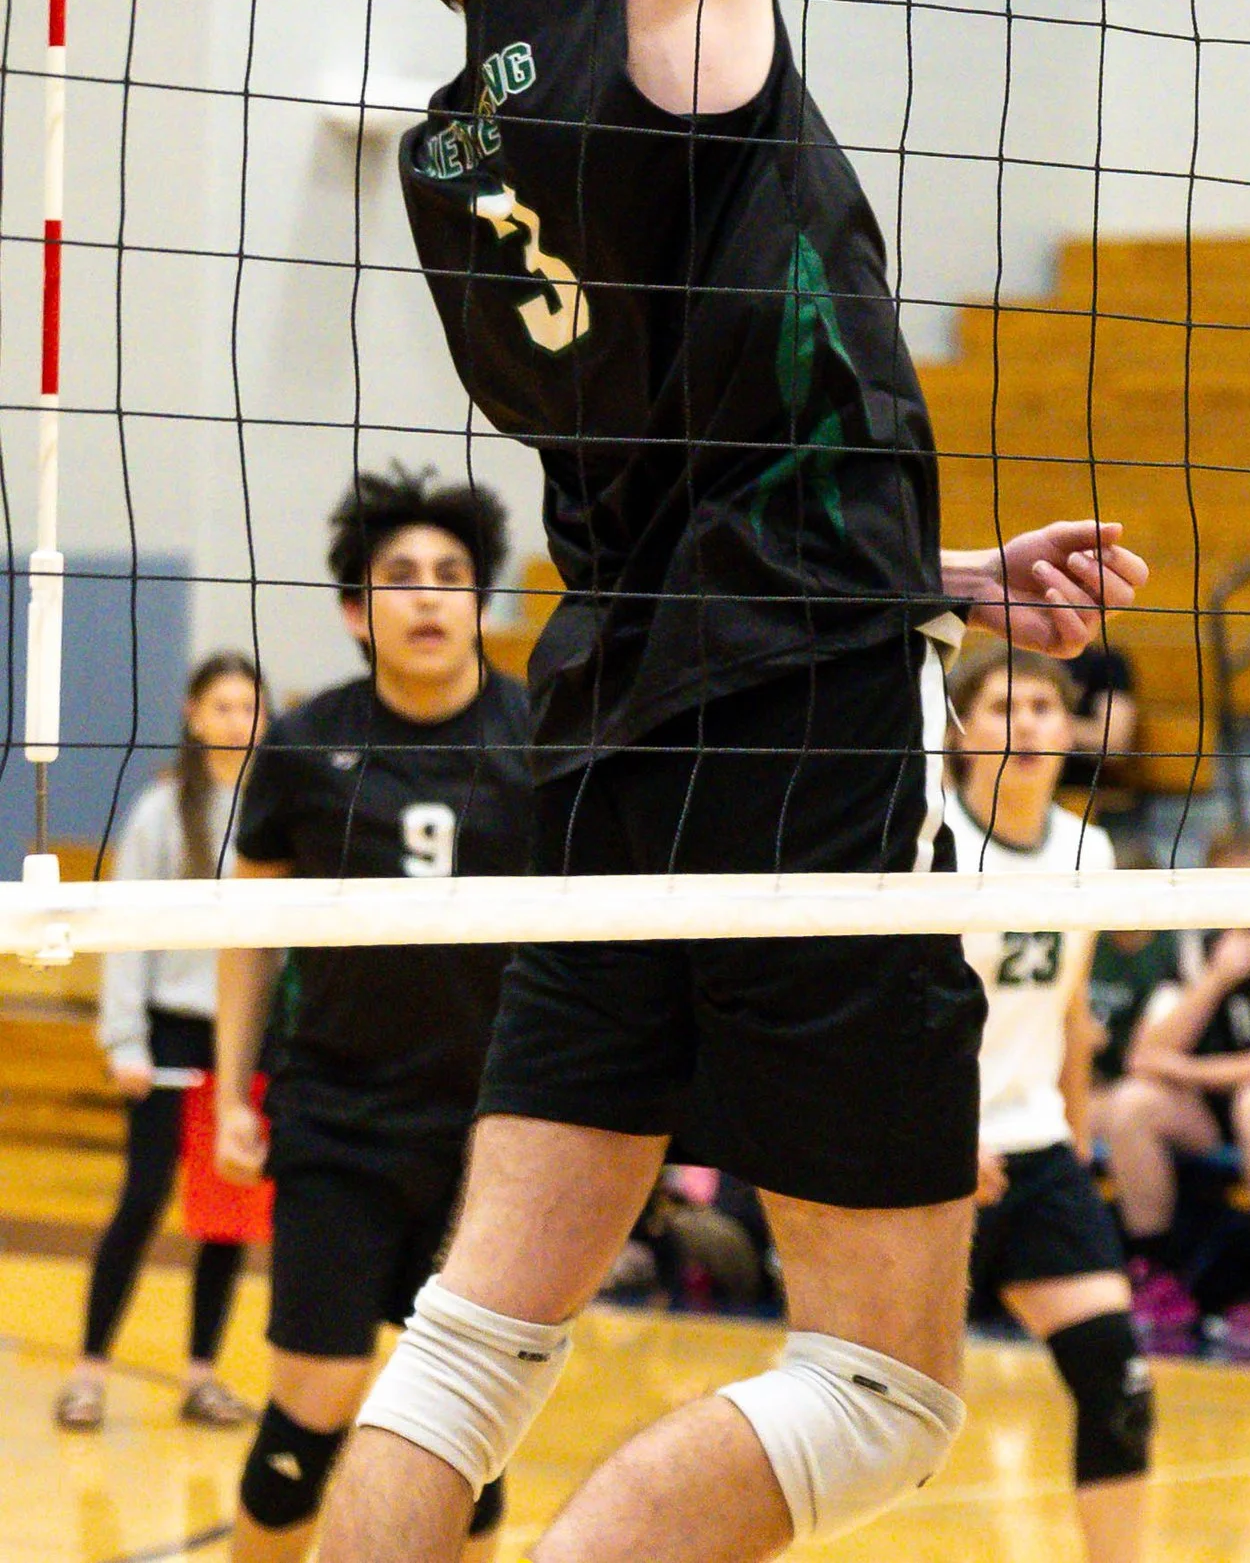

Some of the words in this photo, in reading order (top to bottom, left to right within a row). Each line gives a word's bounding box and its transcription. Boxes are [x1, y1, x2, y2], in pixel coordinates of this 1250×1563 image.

[471, 183, 591, 354] 3
[400, 802, 457, 877] 9
[996, 932, 1062, 985] 23
